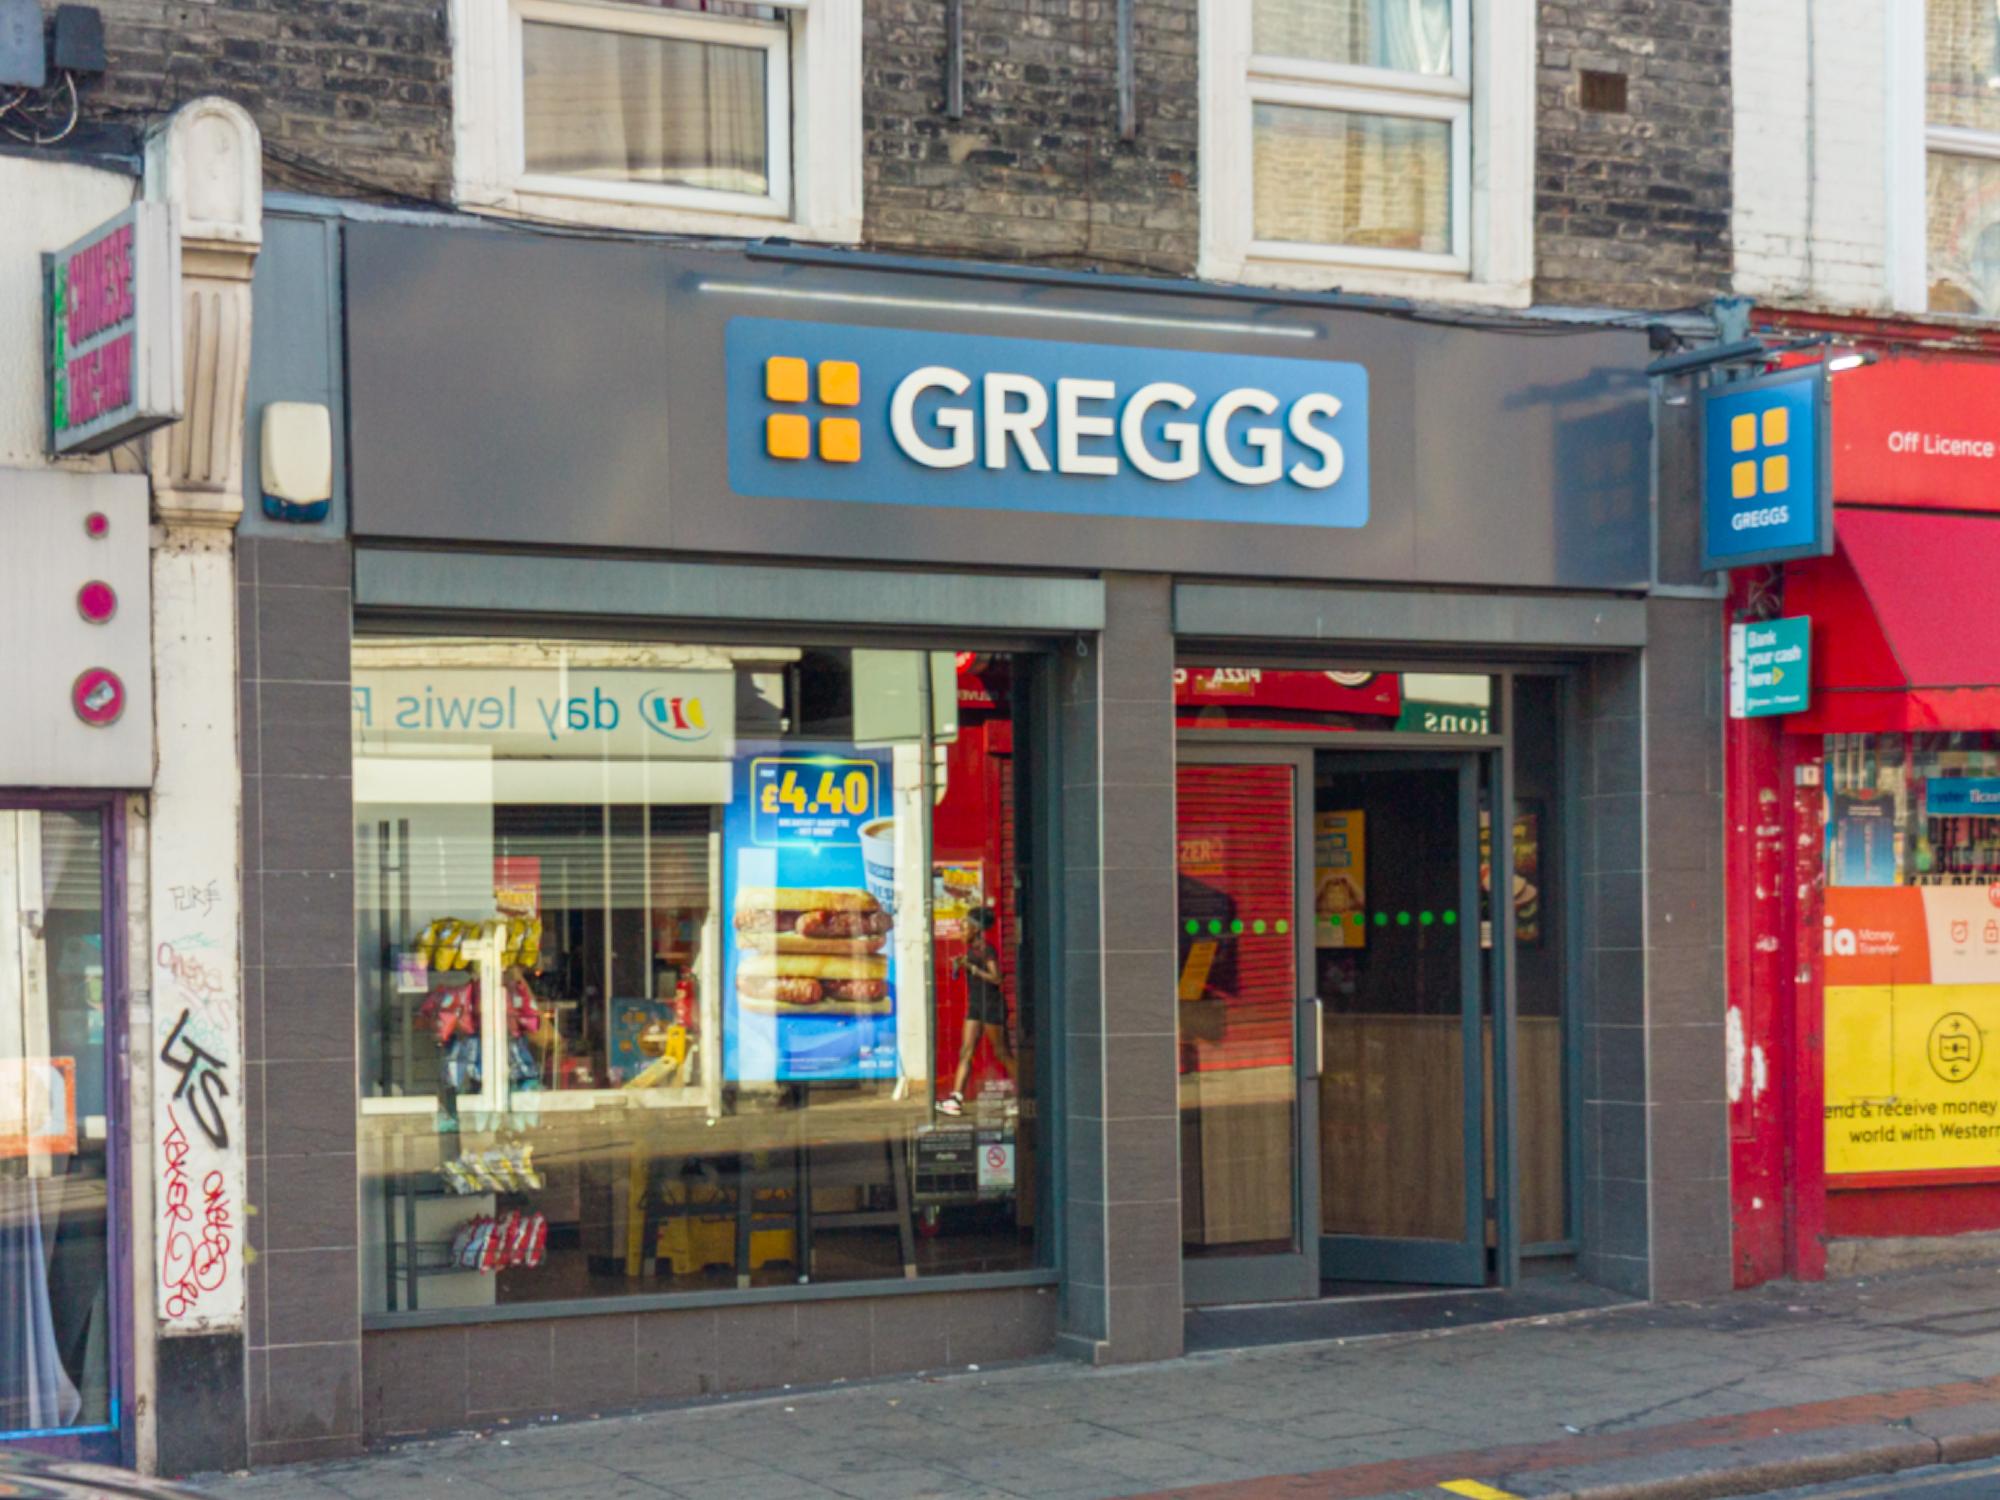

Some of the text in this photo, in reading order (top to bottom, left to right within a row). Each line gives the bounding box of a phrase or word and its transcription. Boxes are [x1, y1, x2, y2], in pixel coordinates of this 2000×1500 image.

[889, 365, 1346, 490] GREGGS
[1888, 430, 1995, 459] Off Licence
[1731, 505, 1790, 532] GREGGS
[761, 770, 869, 815] £4.40
[1859, 929, 1895, 944] Money
[1860, 1101, 1873, 1118] &
[1877, 1102, 1937, 1117] receive
[1943, 1101, 1998, 1117] money
[1849, 1126, 1896, 1144] world
[1900, 1123, 1936, 1142] with
